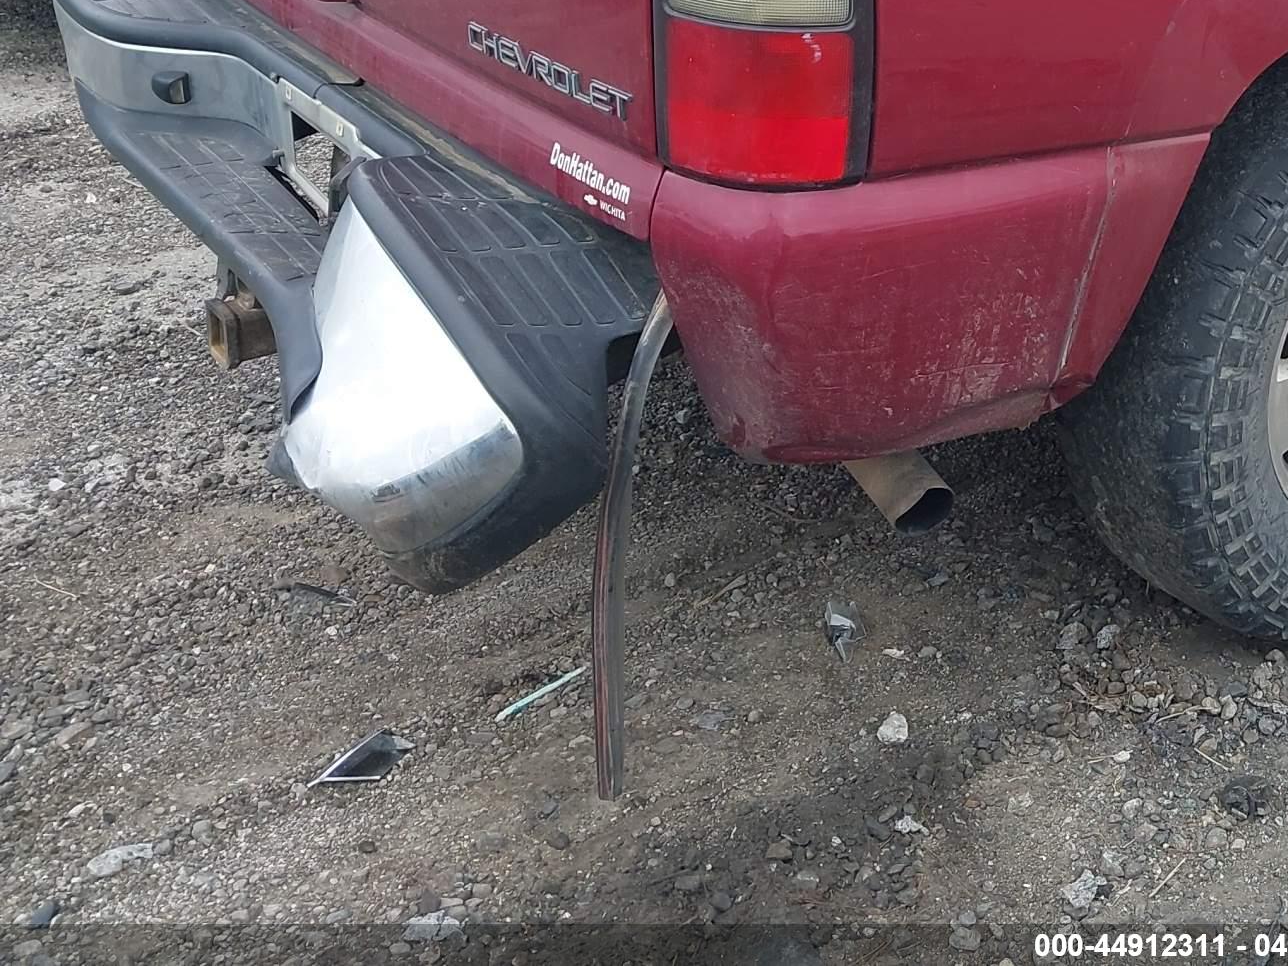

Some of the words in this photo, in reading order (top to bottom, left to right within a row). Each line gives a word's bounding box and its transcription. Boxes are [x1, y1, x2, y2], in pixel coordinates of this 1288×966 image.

[467, 21, 633, 121] CHEVROLET
[549, 142, 631, 205] DonHattan.com
[599, 199, 626, 221] WICHITA
